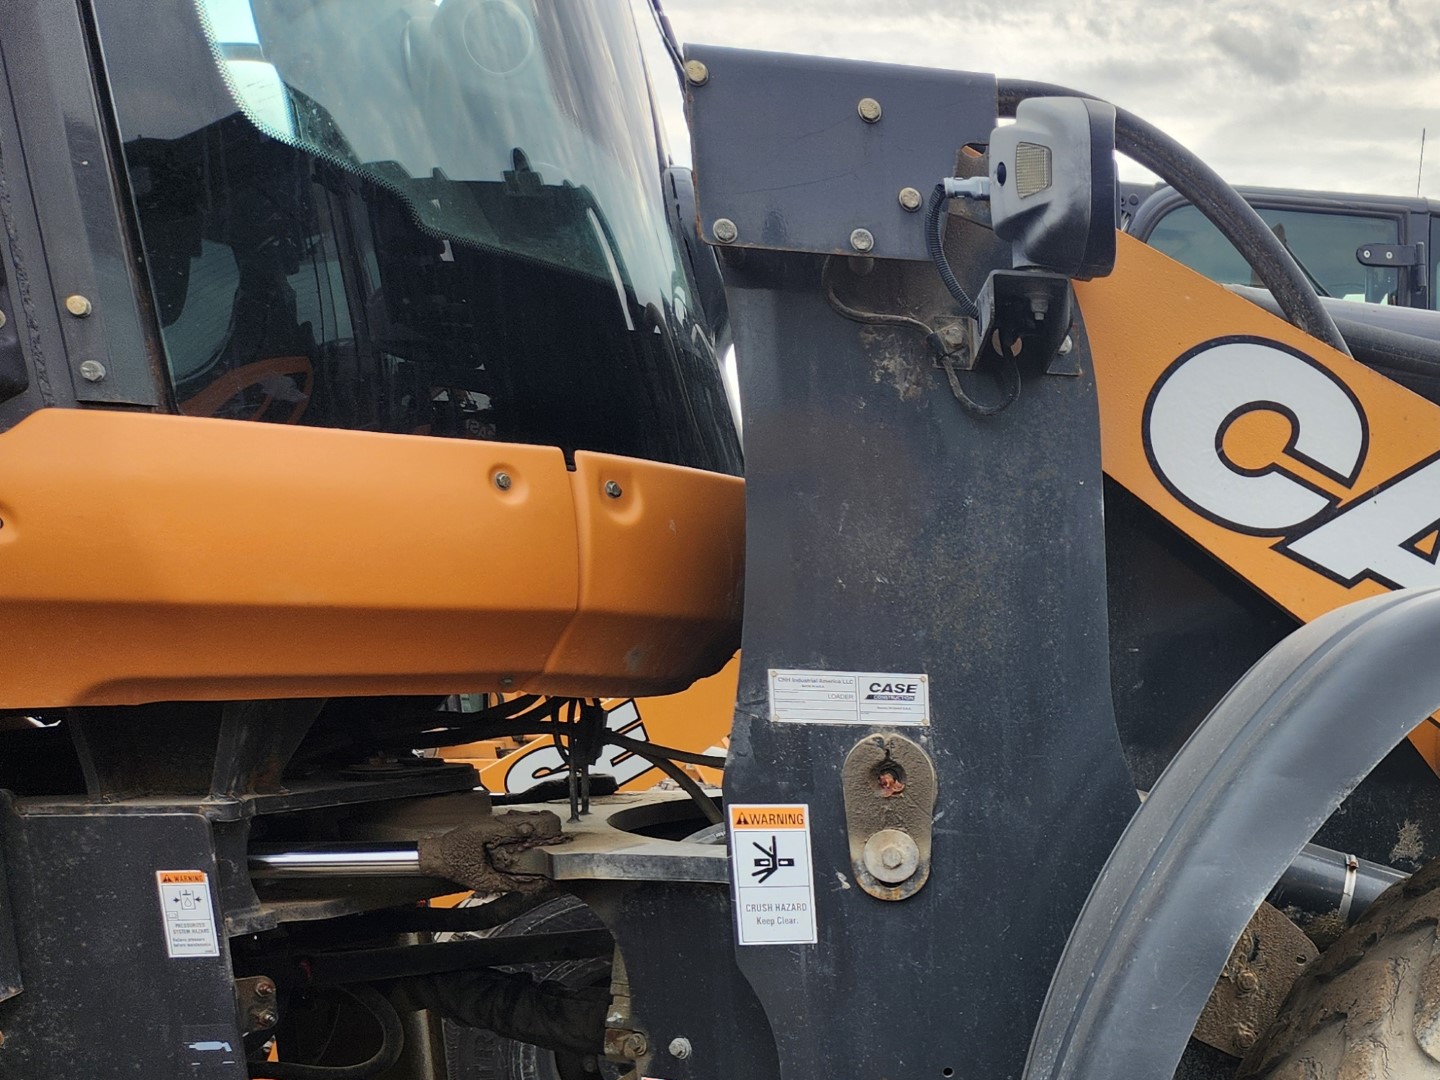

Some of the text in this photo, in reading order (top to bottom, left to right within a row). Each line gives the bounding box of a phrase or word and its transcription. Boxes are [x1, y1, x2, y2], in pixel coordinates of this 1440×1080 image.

[869, 682, 918, 694] CASE
[749, 813, 805, 825] WARNING
[745, 902, 807, 912] CRUSH HAZARD
[756, 916, 799, 925] Keep Clear.
